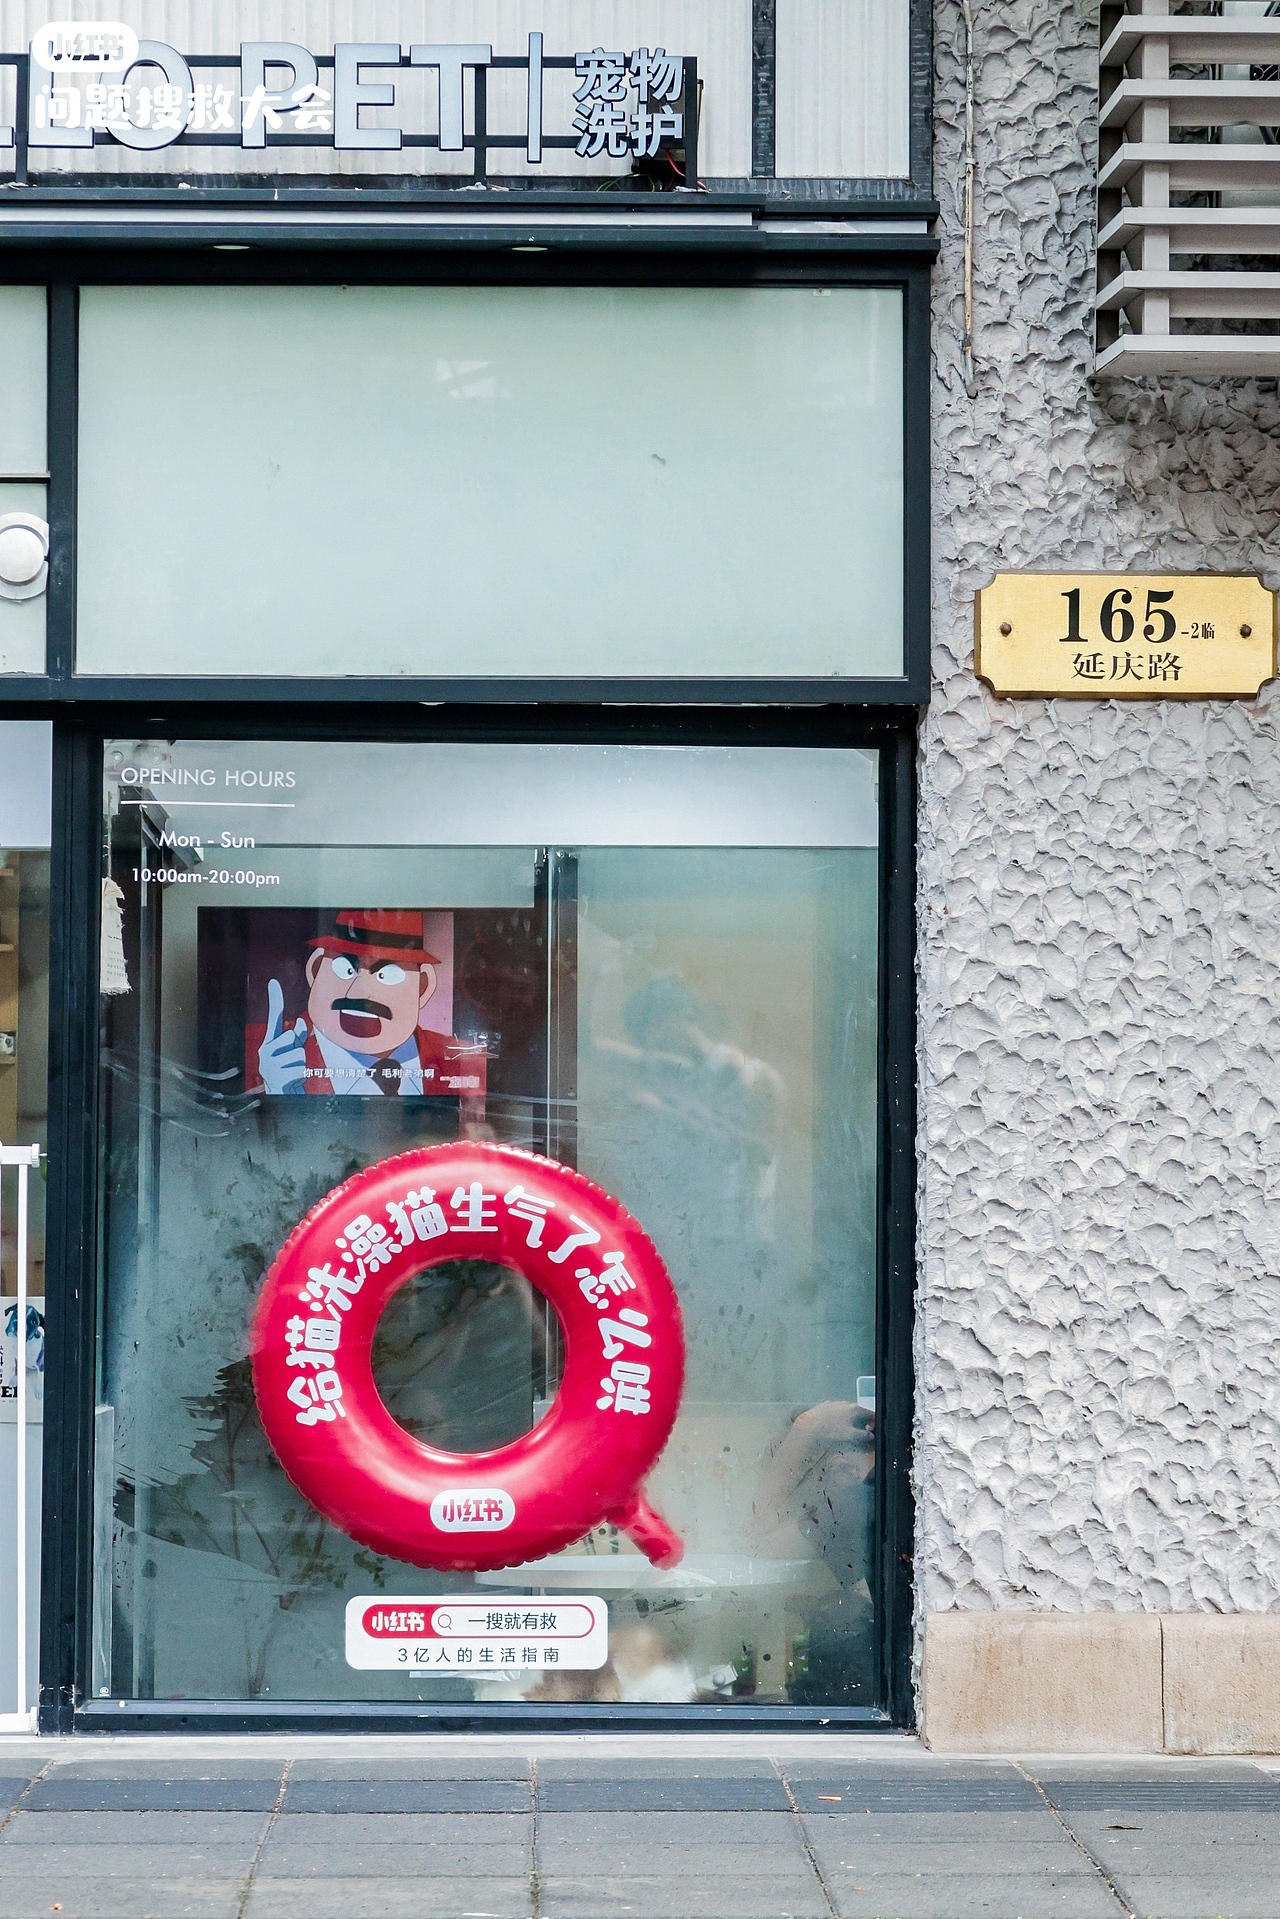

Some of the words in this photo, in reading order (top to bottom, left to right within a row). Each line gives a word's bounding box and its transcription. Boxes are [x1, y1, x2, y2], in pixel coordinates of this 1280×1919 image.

[573, 47, 684, 103] 宠物
[0, 39, 195, 151] LO
[240, 41, 493, 152] PET
[572, 103, 684, 158] 洗护
[1071, 652, 1183, 681] 延庆路
[120, 767, 216, 786] OPENING
[225, 769, 296, 788] HOURS
[158, 830, 201, 847] Mon
[220, 831, 255, 848] Sun
[131, 868, 280, 887] 10:00am-20:00pm
[285, 1181, 652, 1426] 给猫洗澡猫生气了怎么哄
[442, 1498, 504, 1523] 小红书
[371, 1611, 425, 1632] 小红书
[468, 1612, 558, 1630] 一搜就有救
[397, 1647, 560, 1663] 3亿人的生活指南
